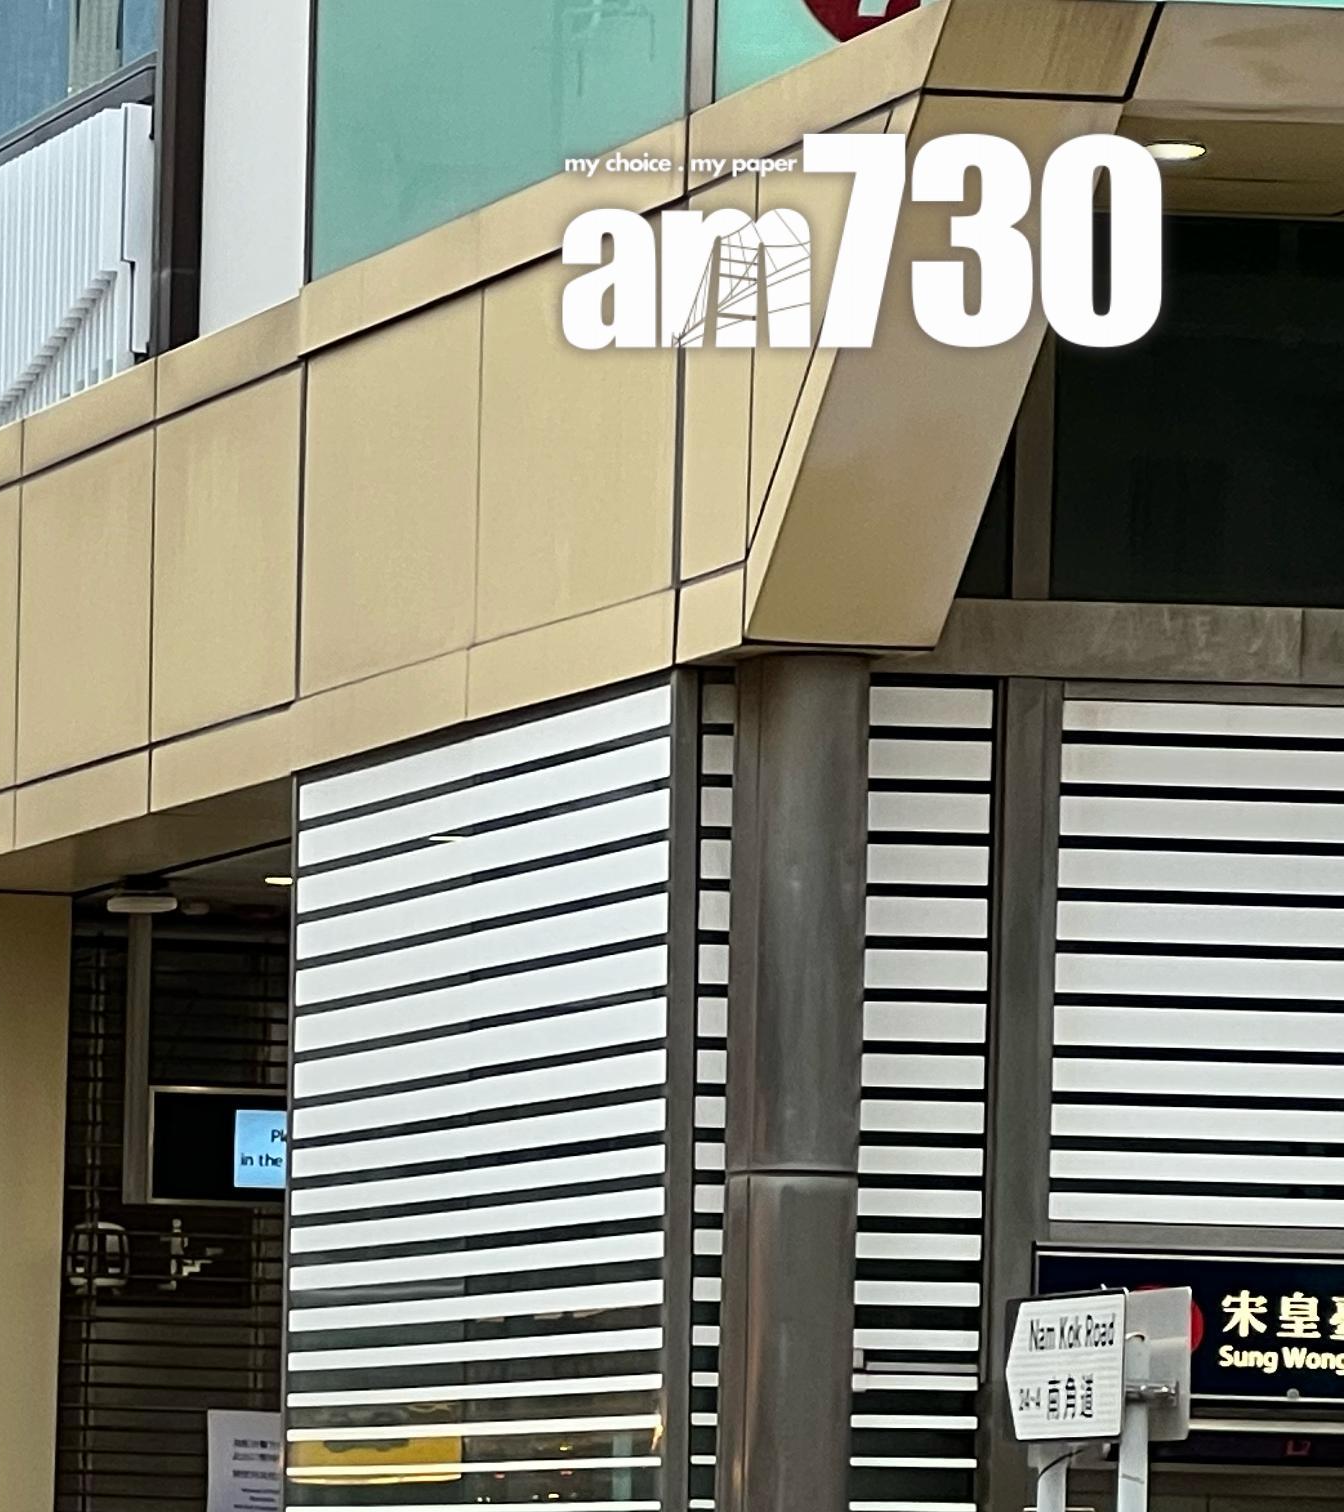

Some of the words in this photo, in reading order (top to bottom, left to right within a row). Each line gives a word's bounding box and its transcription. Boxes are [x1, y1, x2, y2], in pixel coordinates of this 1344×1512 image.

[241, 1152, 254, 1166] in
[259, 1153, 284, 1167] the
[1028, 1318, 1056, 1352] Nam
[1059, 1315, 1082, 1349] Kok
[1085, 1312, 1116, 1348] Road
[1218, 1344, 1279, 1374] Sung
